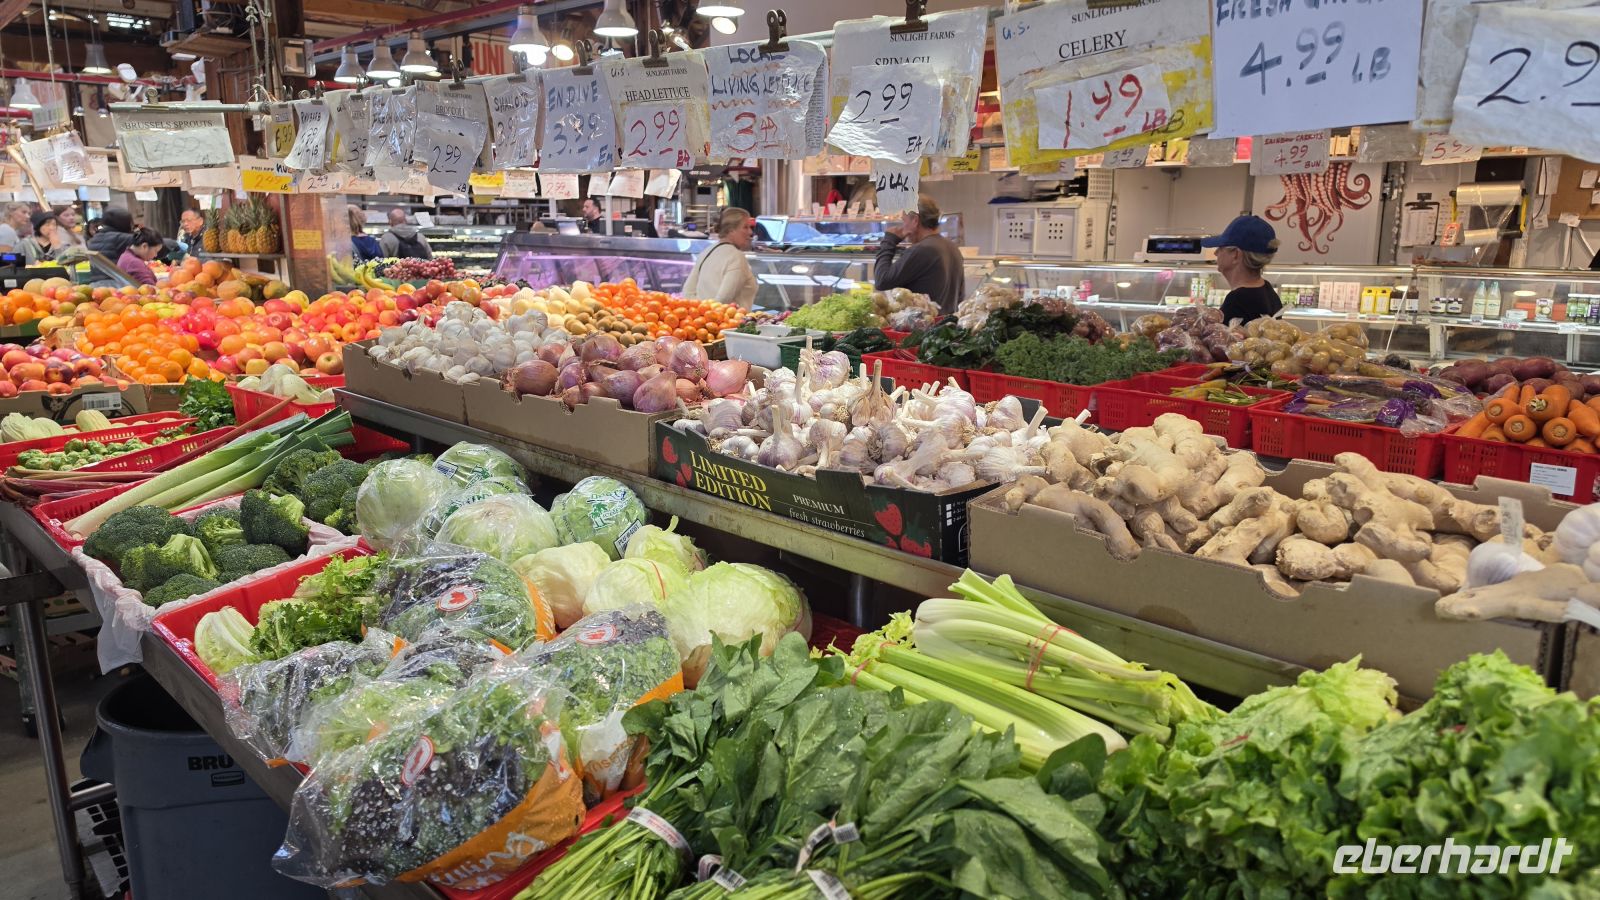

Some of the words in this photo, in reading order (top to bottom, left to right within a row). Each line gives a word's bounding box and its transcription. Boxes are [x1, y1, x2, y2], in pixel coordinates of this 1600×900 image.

[1071, 5, 1123, 24] SUNLIGHT
[889, 32, 929, 43] SUNLIGHT
[930, 30, 956, 40] FARMS
[1058, 29, 1128, 59] CELERY
[1239, 21, 1346, 96] 4.99
[1352, 46, 1392, 84] LB
[548, 80, 598, 112] ENDIVE
[625, 88, 653, 101] HEAD
[653, 86, 691, 100] LETTUCE
[711, 73, 760, 97] LIVING
[844, 82, 914, 125] 2.99
[1063, 73, 1143, 149] 1.49
[124, 121, 171, 130] BRUSSELS
[173, 119, 213, 128] SPROUTS
[628, 109, 680, 157] 2.99
[1142, 108, 1168, 132] LB
[905, 135, 923, 154] EA
[1274, 144, 1309, 169] 4.99
[430, 144, 462, 173] 2.99
[676, 149, 691, 168] EA
[689, 450, 767, 493] LIMITED
[694, 470, 773, 512] EDITION
[792, 494, 845, 515] PREMIUM
[789, 508, 809, 524] fresh
[811, 516, 866, 538] strawberries
